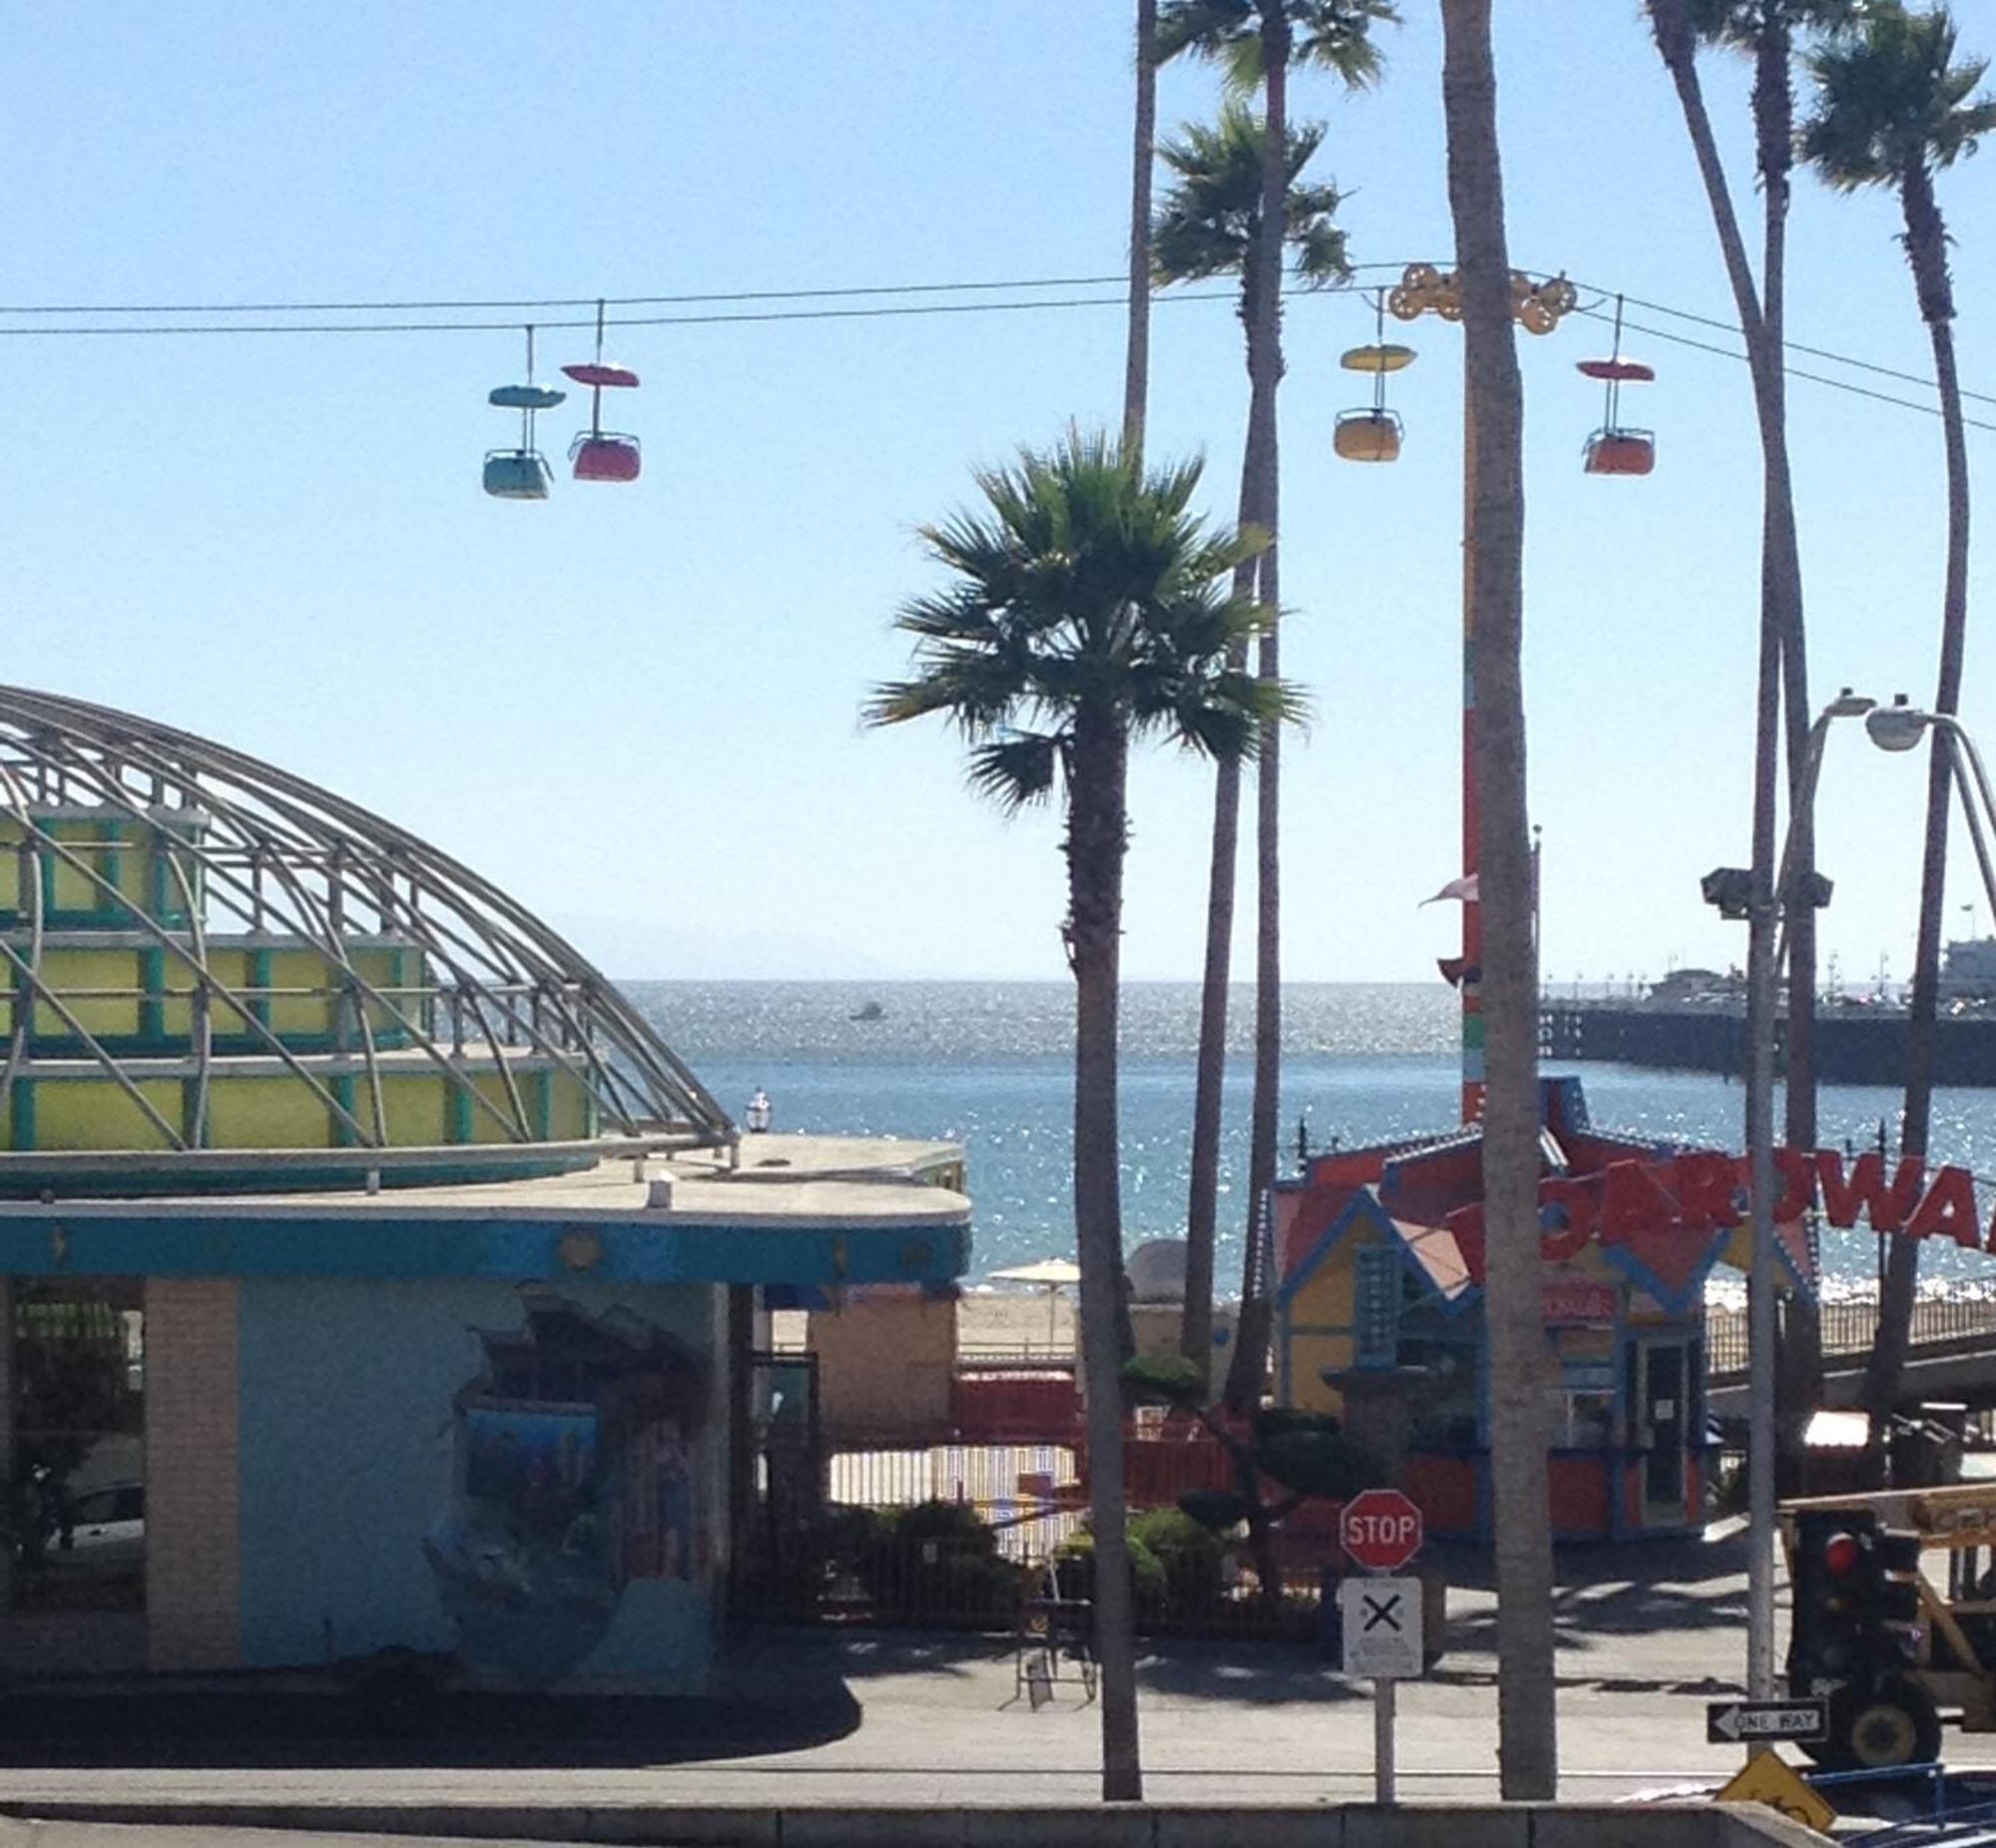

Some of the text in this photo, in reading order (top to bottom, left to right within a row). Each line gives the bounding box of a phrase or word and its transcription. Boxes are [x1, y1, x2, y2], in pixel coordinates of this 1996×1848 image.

[1348, 1515, 1415, 1546] STOP
[1734, 1712, 1814, 1730] ONE WAY
